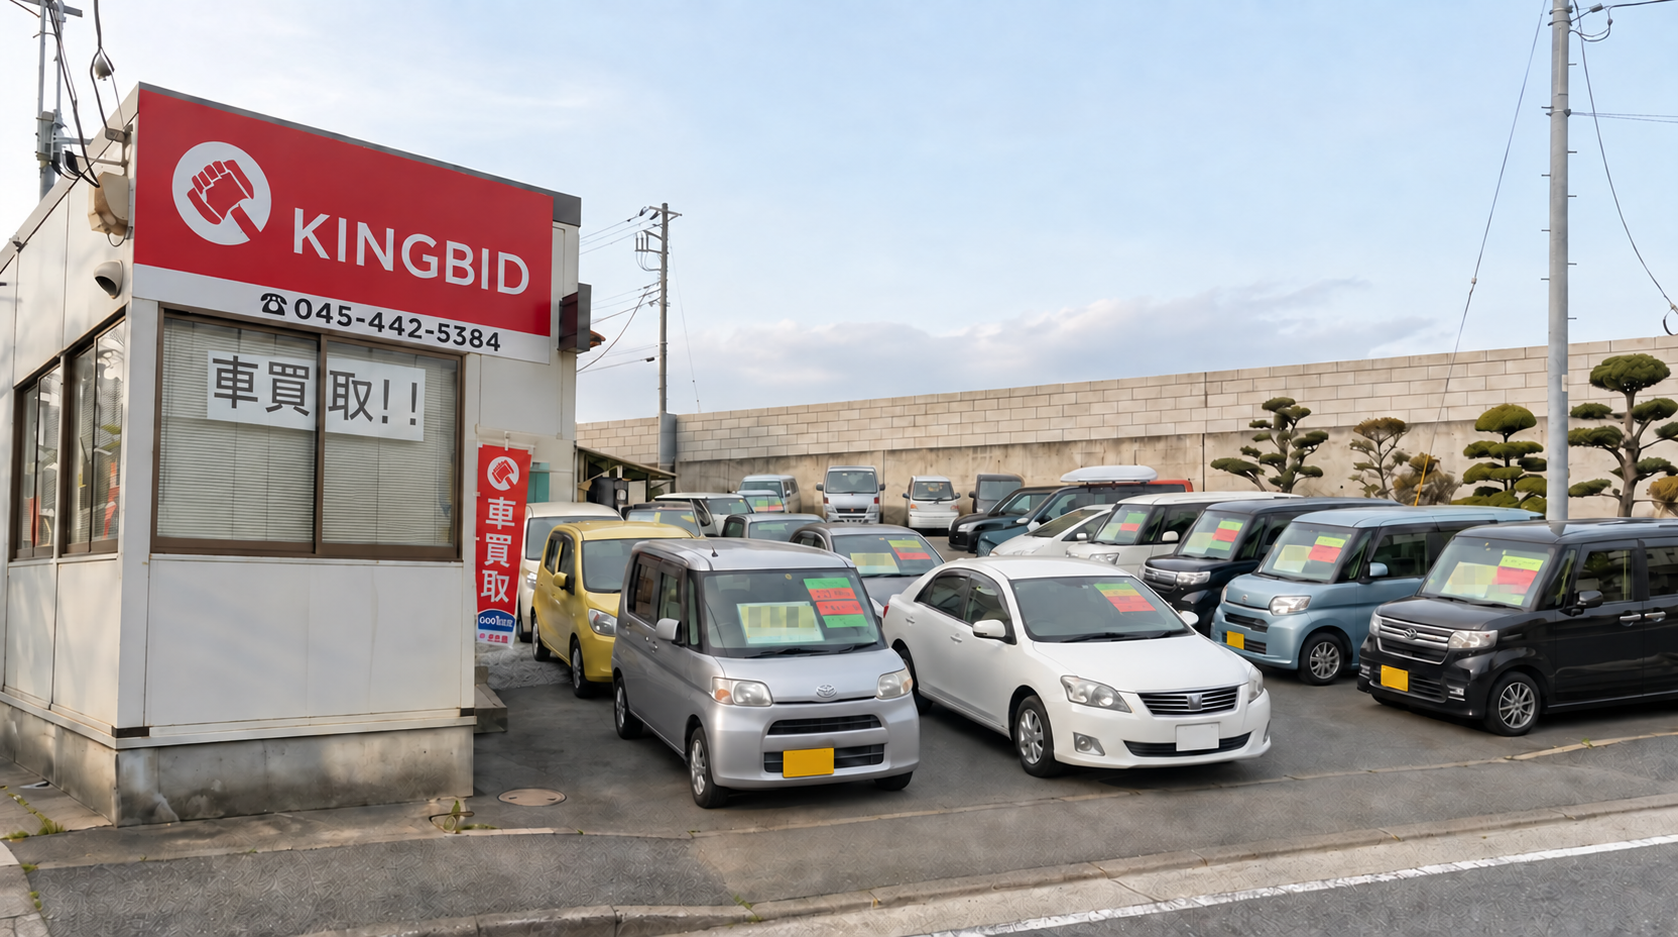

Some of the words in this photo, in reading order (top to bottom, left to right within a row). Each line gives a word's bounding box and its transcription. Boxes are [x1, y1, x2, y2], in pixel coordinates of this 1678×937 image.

[294, 207, 530, 296] KINGBID
[294, 298, 500, 351] 045-442-5384
[480, 496, 517, 604] 車買取
